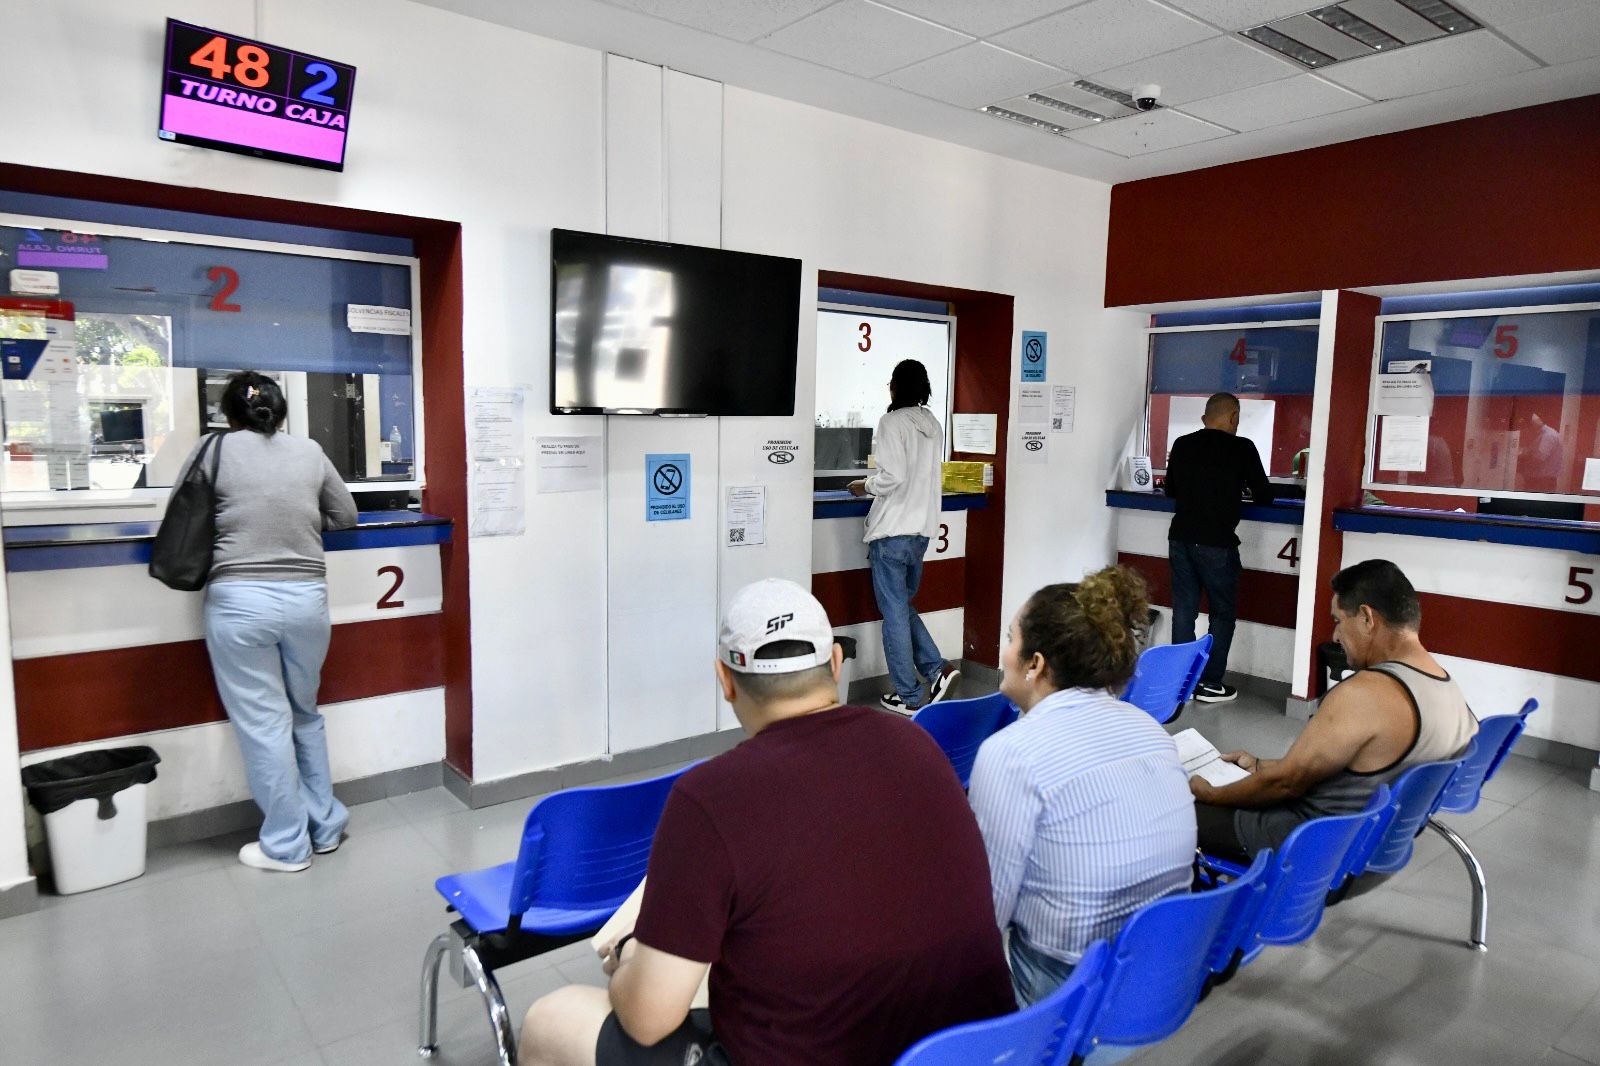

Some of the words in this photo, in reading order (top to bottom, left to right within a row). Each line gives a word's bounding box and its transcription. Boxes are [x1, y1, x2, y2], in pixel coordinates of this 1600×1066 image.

[190, 36, 270, 88] 48
[301, 62, 338, 105] 2
[180, 79, 277, 113] TURNO
[285, 104, 345, 129] CAJA
[208, 266, 241, 312] 2
[858, 322, 872, 352] 3
[1229, 337, 1246, 365] 4
[1494, 325, 1519, 359] 5
[936, 524, 949, 553] 3
[1277, 537, 1300, 567] 4
[377, 565, 404, 609] 2
[1565, 566, 1594, 604] 5
[765, 612, 794, 635] SP
